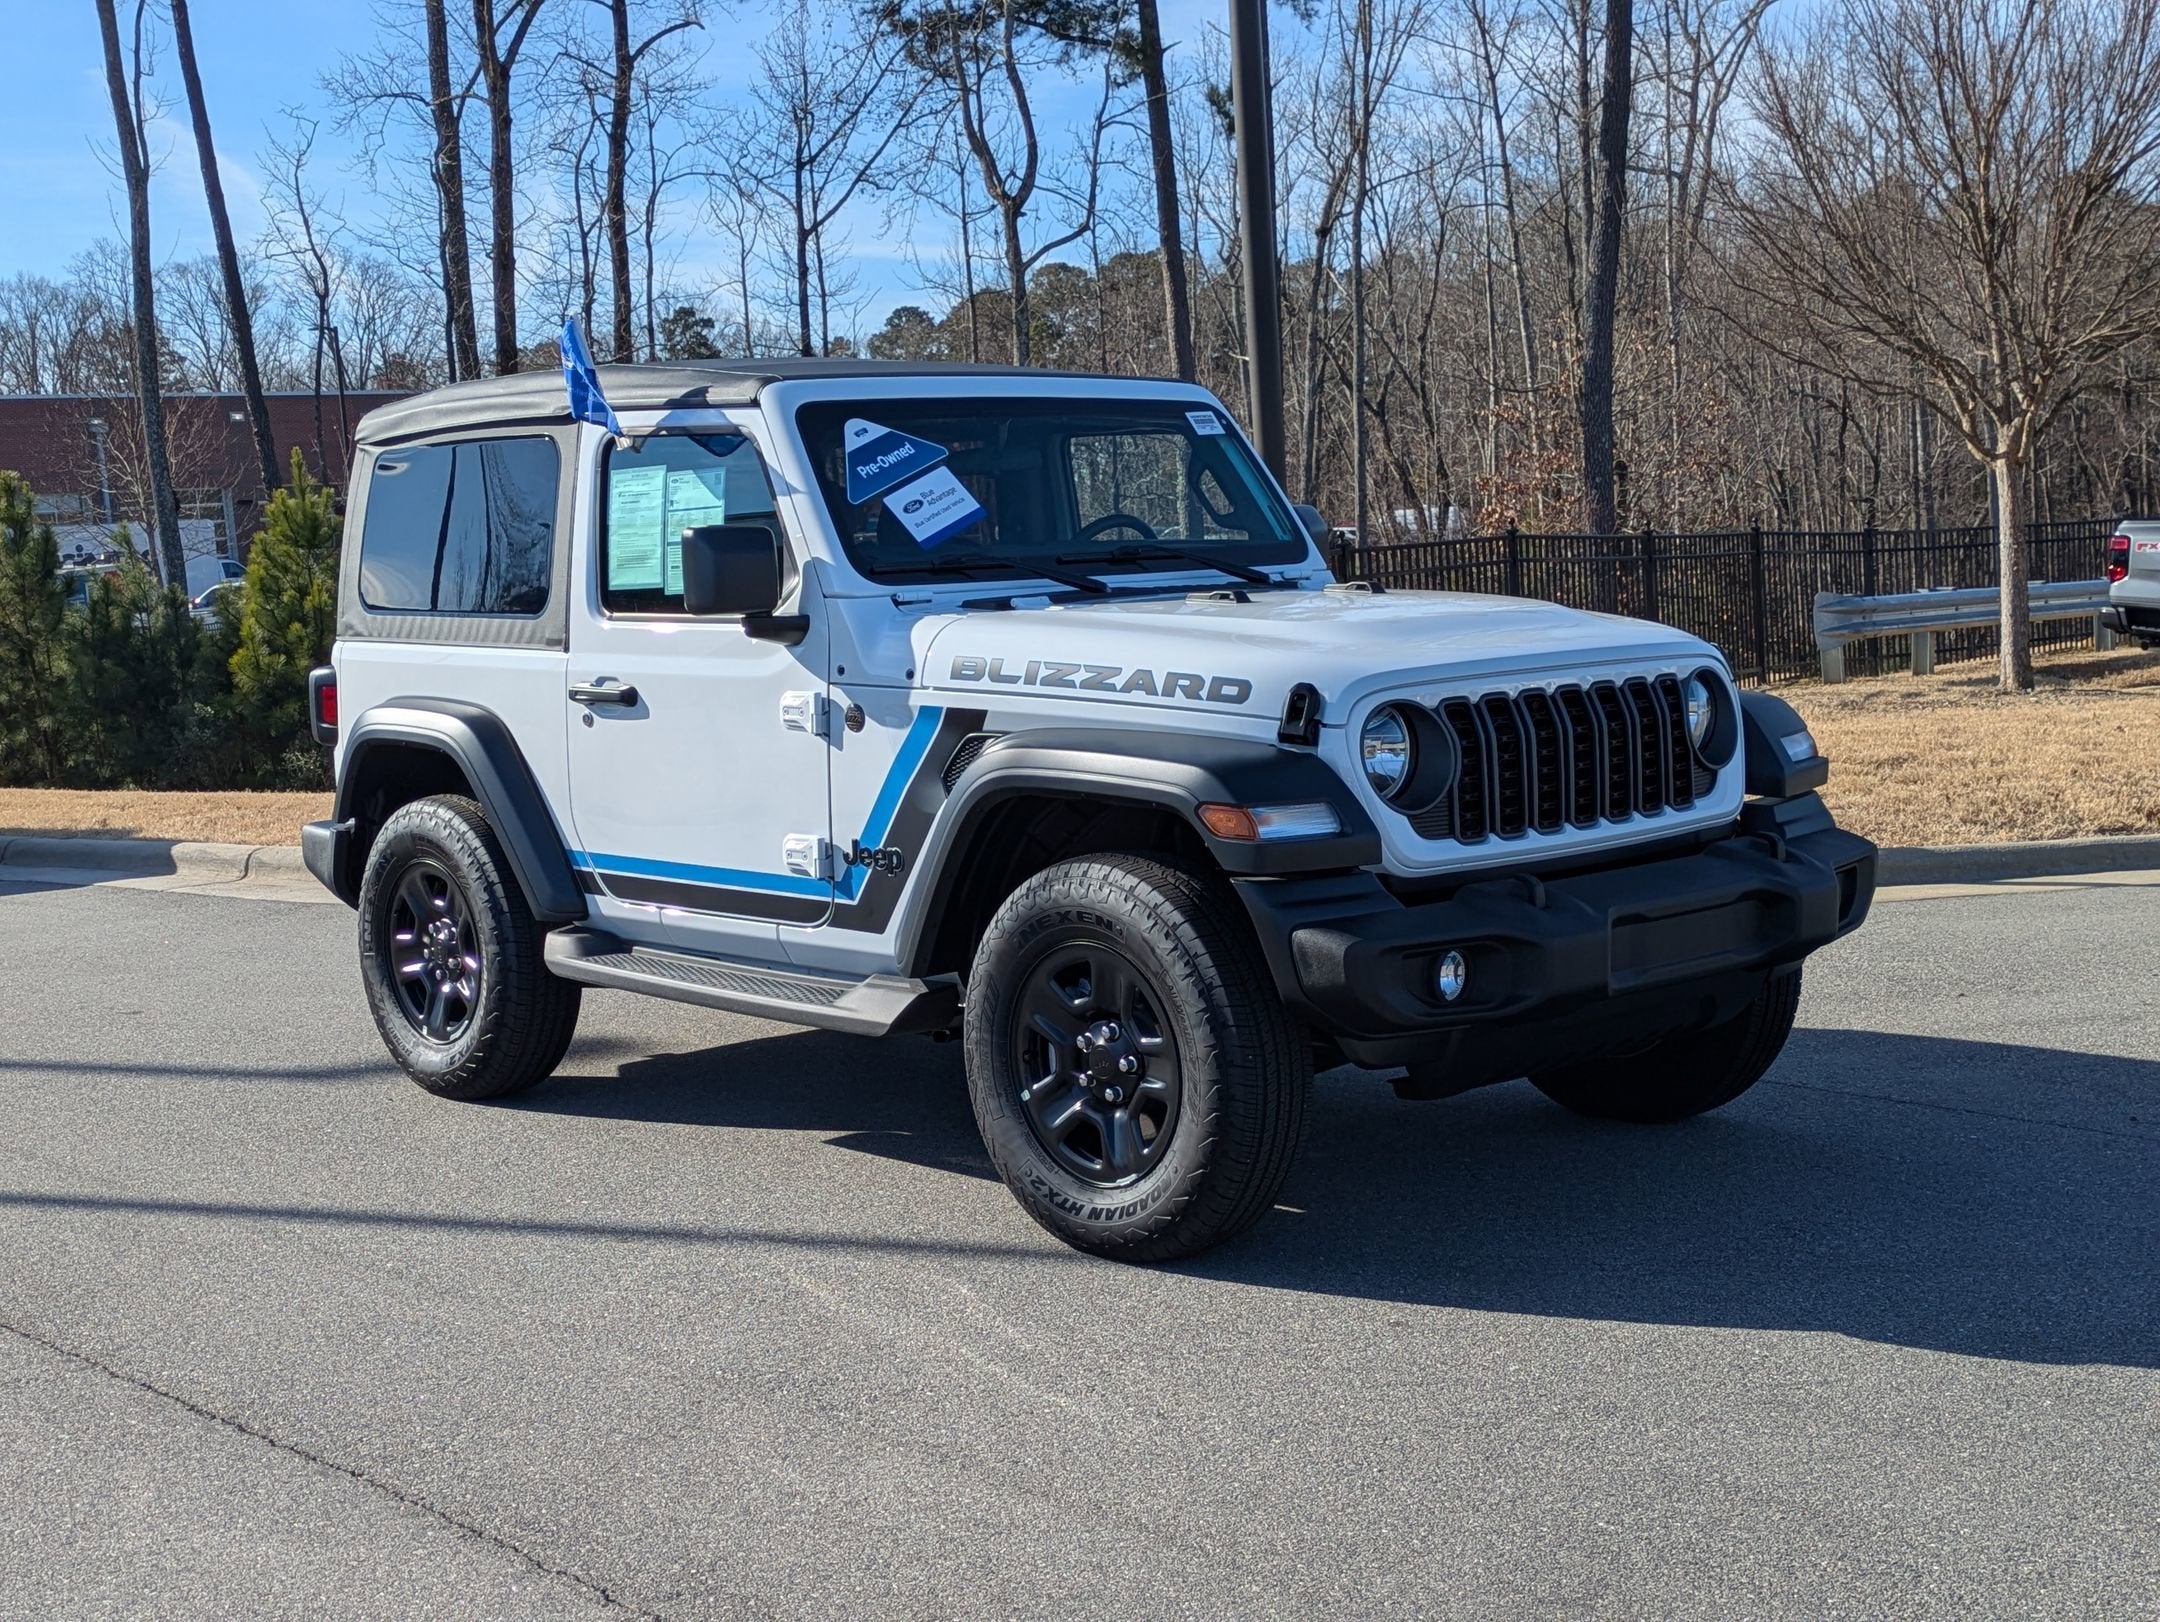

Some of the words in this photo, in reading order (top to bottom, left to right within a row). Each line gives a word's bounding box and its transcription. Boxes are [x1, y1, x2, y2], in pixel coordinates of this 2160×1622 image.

[856, 441, 916, 479] Pre-Owned
[949, 655, 1253, 705] BLIZZARD
[843, 838, 905, 877] Jeep
[1018, 909, 1114, 946] NEXEN
[1029, 1174, 1086, 1217] HTX2
